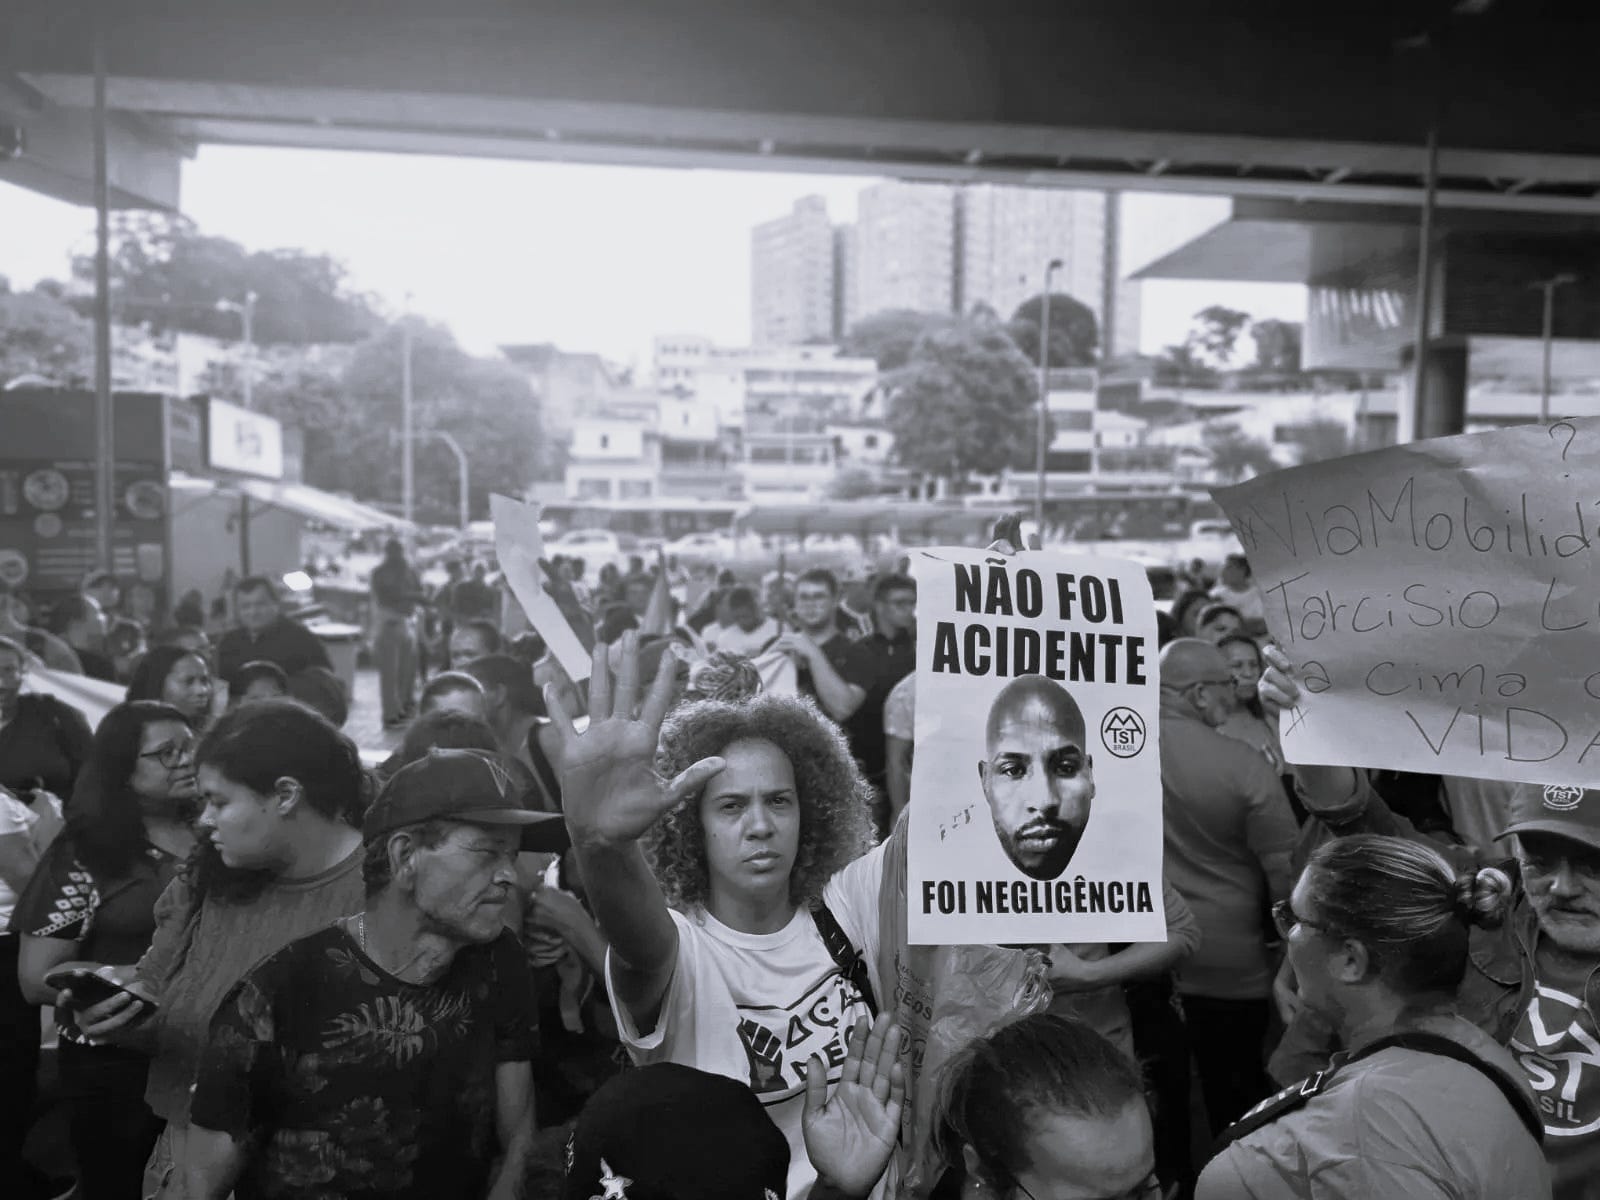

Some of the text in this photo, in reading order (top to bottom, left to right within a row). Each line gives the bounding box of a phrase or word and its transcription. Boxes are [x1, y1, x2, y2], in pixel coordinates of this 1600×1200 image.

[953, 556, 1124, 625] NÃO FOI
[931, 621, 1147, 685] ACIDENTE
[1112, 744, 1137, 752] BRASIL
[921, 874, 1155, 915] FOI NEGLIGÊNCIA
